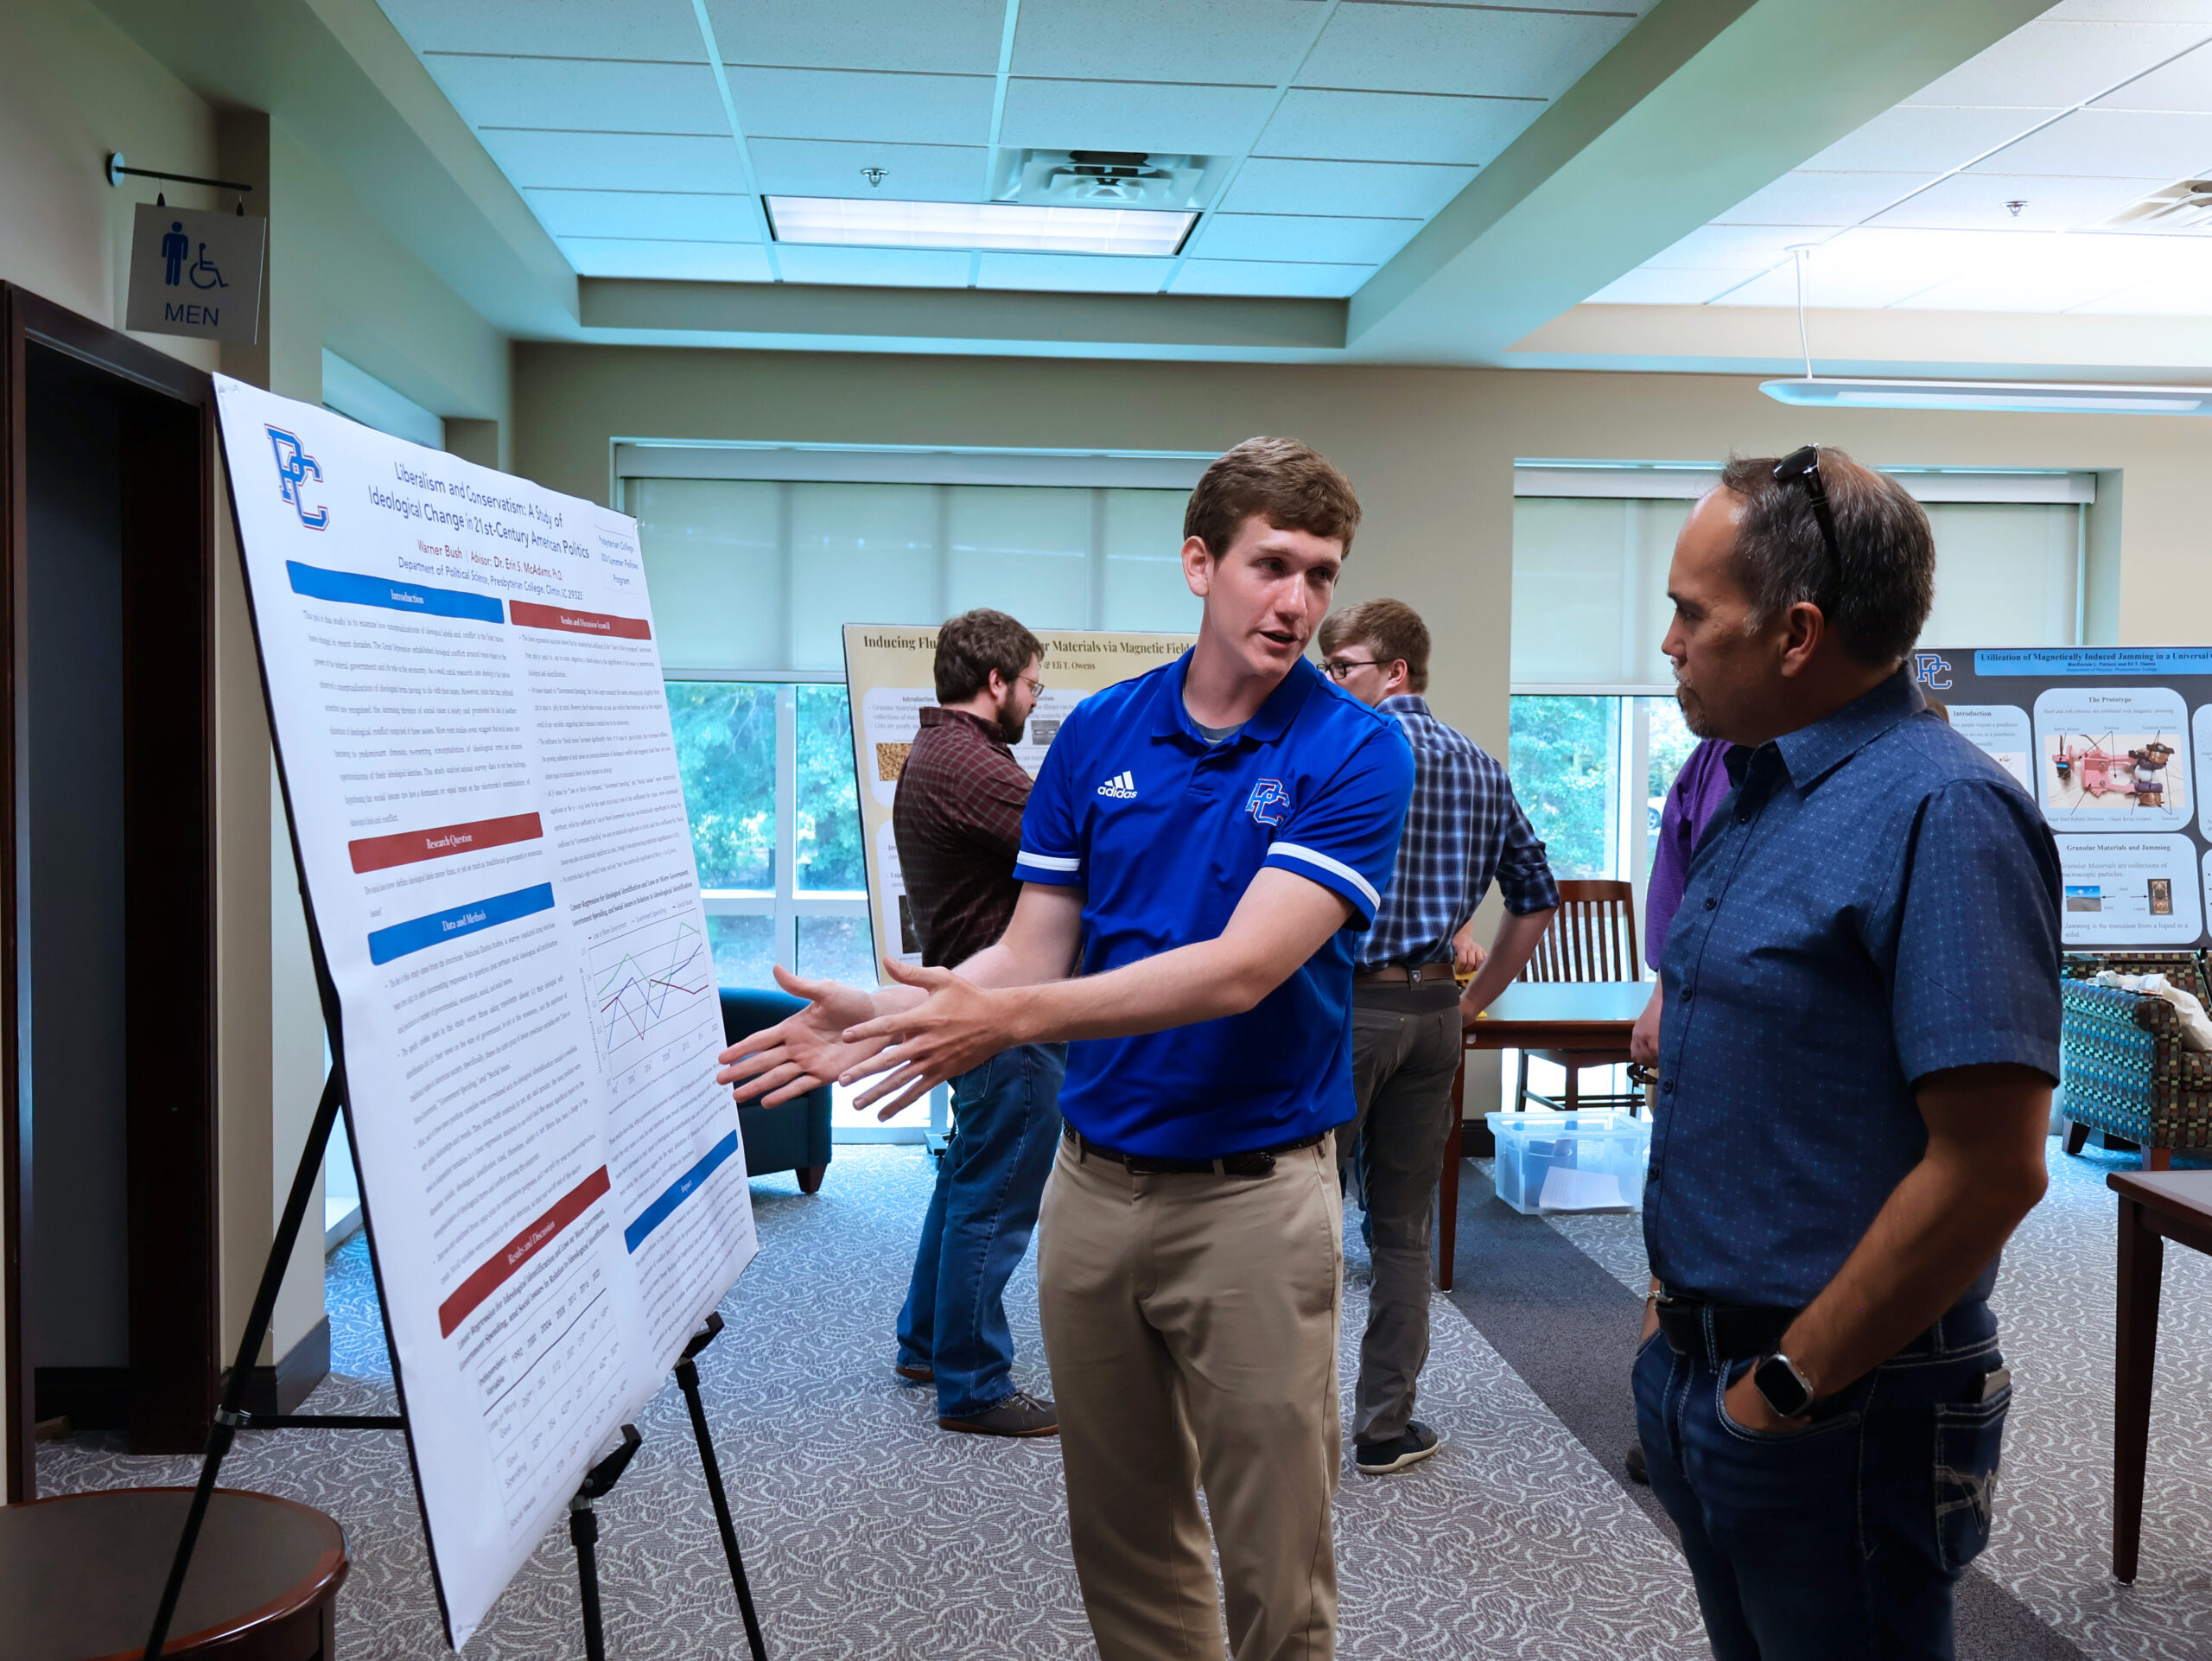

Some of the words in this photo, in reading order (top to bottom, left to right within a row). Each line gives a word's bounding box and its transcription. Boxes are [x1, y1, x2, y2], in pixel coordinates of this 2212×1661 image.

[164, 302, 219, 327] MEN
[394, 461, 446, 494] Liberalism
[448, 481, 466, 500] and
[467, 484, 526, 517] Conservatism:
[528, 502, 535, 519] A
[535, 505, 552, 529] Study
[554, 512, 563, 529] of
[368, 485, 422, 519] Ideological
[423, 502, 465, 531] Change
[466, 512, 474, 531] in
[474, 516, 529, 548] 21st-Century
[531, 530, 561, 554] American
[563, 539, 589, 559] Politics
[417, 538, 443, 556] Warner
[444, 544, 463, 560] Bush
[471, 550, 493, 567] Advisor:
[493, 556, 505, 569] Dr.
[505, 557, 517, 571] Erin
[524, 562, 551, 578] McAdams,
[398, 556, 435, 575] Department
[435, 563, 445, 576] of
[446, 566, 470, 582] Political
[490, 575, 524, 590] Presbyterian
[391, 589, 424, 605] Introduction
[864, 635, 916, 652] Inducing
[1052, 640, 1102, 653] Materials
[1103, 642, 1118, 653] via
[1120, 642, 1165, 656] Magnetic
[1052, 660, 1062, 670] Eli
[1071, 662, 1096, 671] Owens
[1981, 653, 2021, 662] Utilization
[2034, 652, 2082, 663] Magnetically
[2118, 652, 2154, 661] Jamming
[1097, 785, 1137, 799] adidas
[426, 835, 450, 850] Research
[449, 833, 473, 847] Question
[442, 920, 456, 932] Data
[456, 914, 467, 927] and
[467, 909, 486, 925] Methods
[508, 1245, 525, 1265] Results
[524, 1236, 533, 1251] and
[532, 1221, 556, 1244] Discussion
